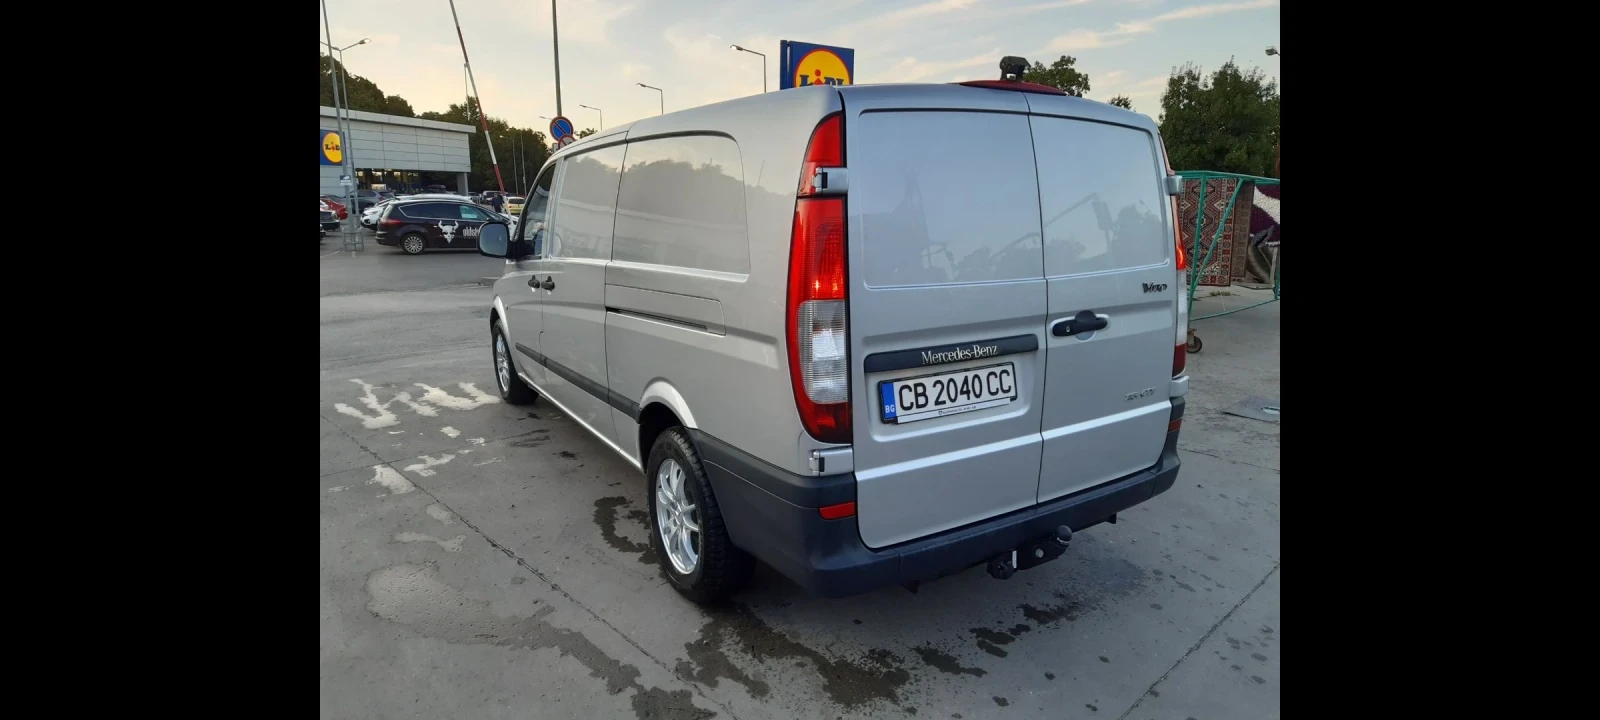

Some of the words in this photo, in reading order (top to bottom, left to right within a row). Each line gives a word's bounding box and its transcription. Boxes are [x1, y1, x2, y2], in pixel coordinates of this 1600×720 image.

[921, 344, 998, 365] Mercedes-Benz
[898, 382, 929, 411] CB
[932, 373, 983, 406] 2040
[986, 369, 1012, 396] CC
[885, 404, 895, 414] BG
